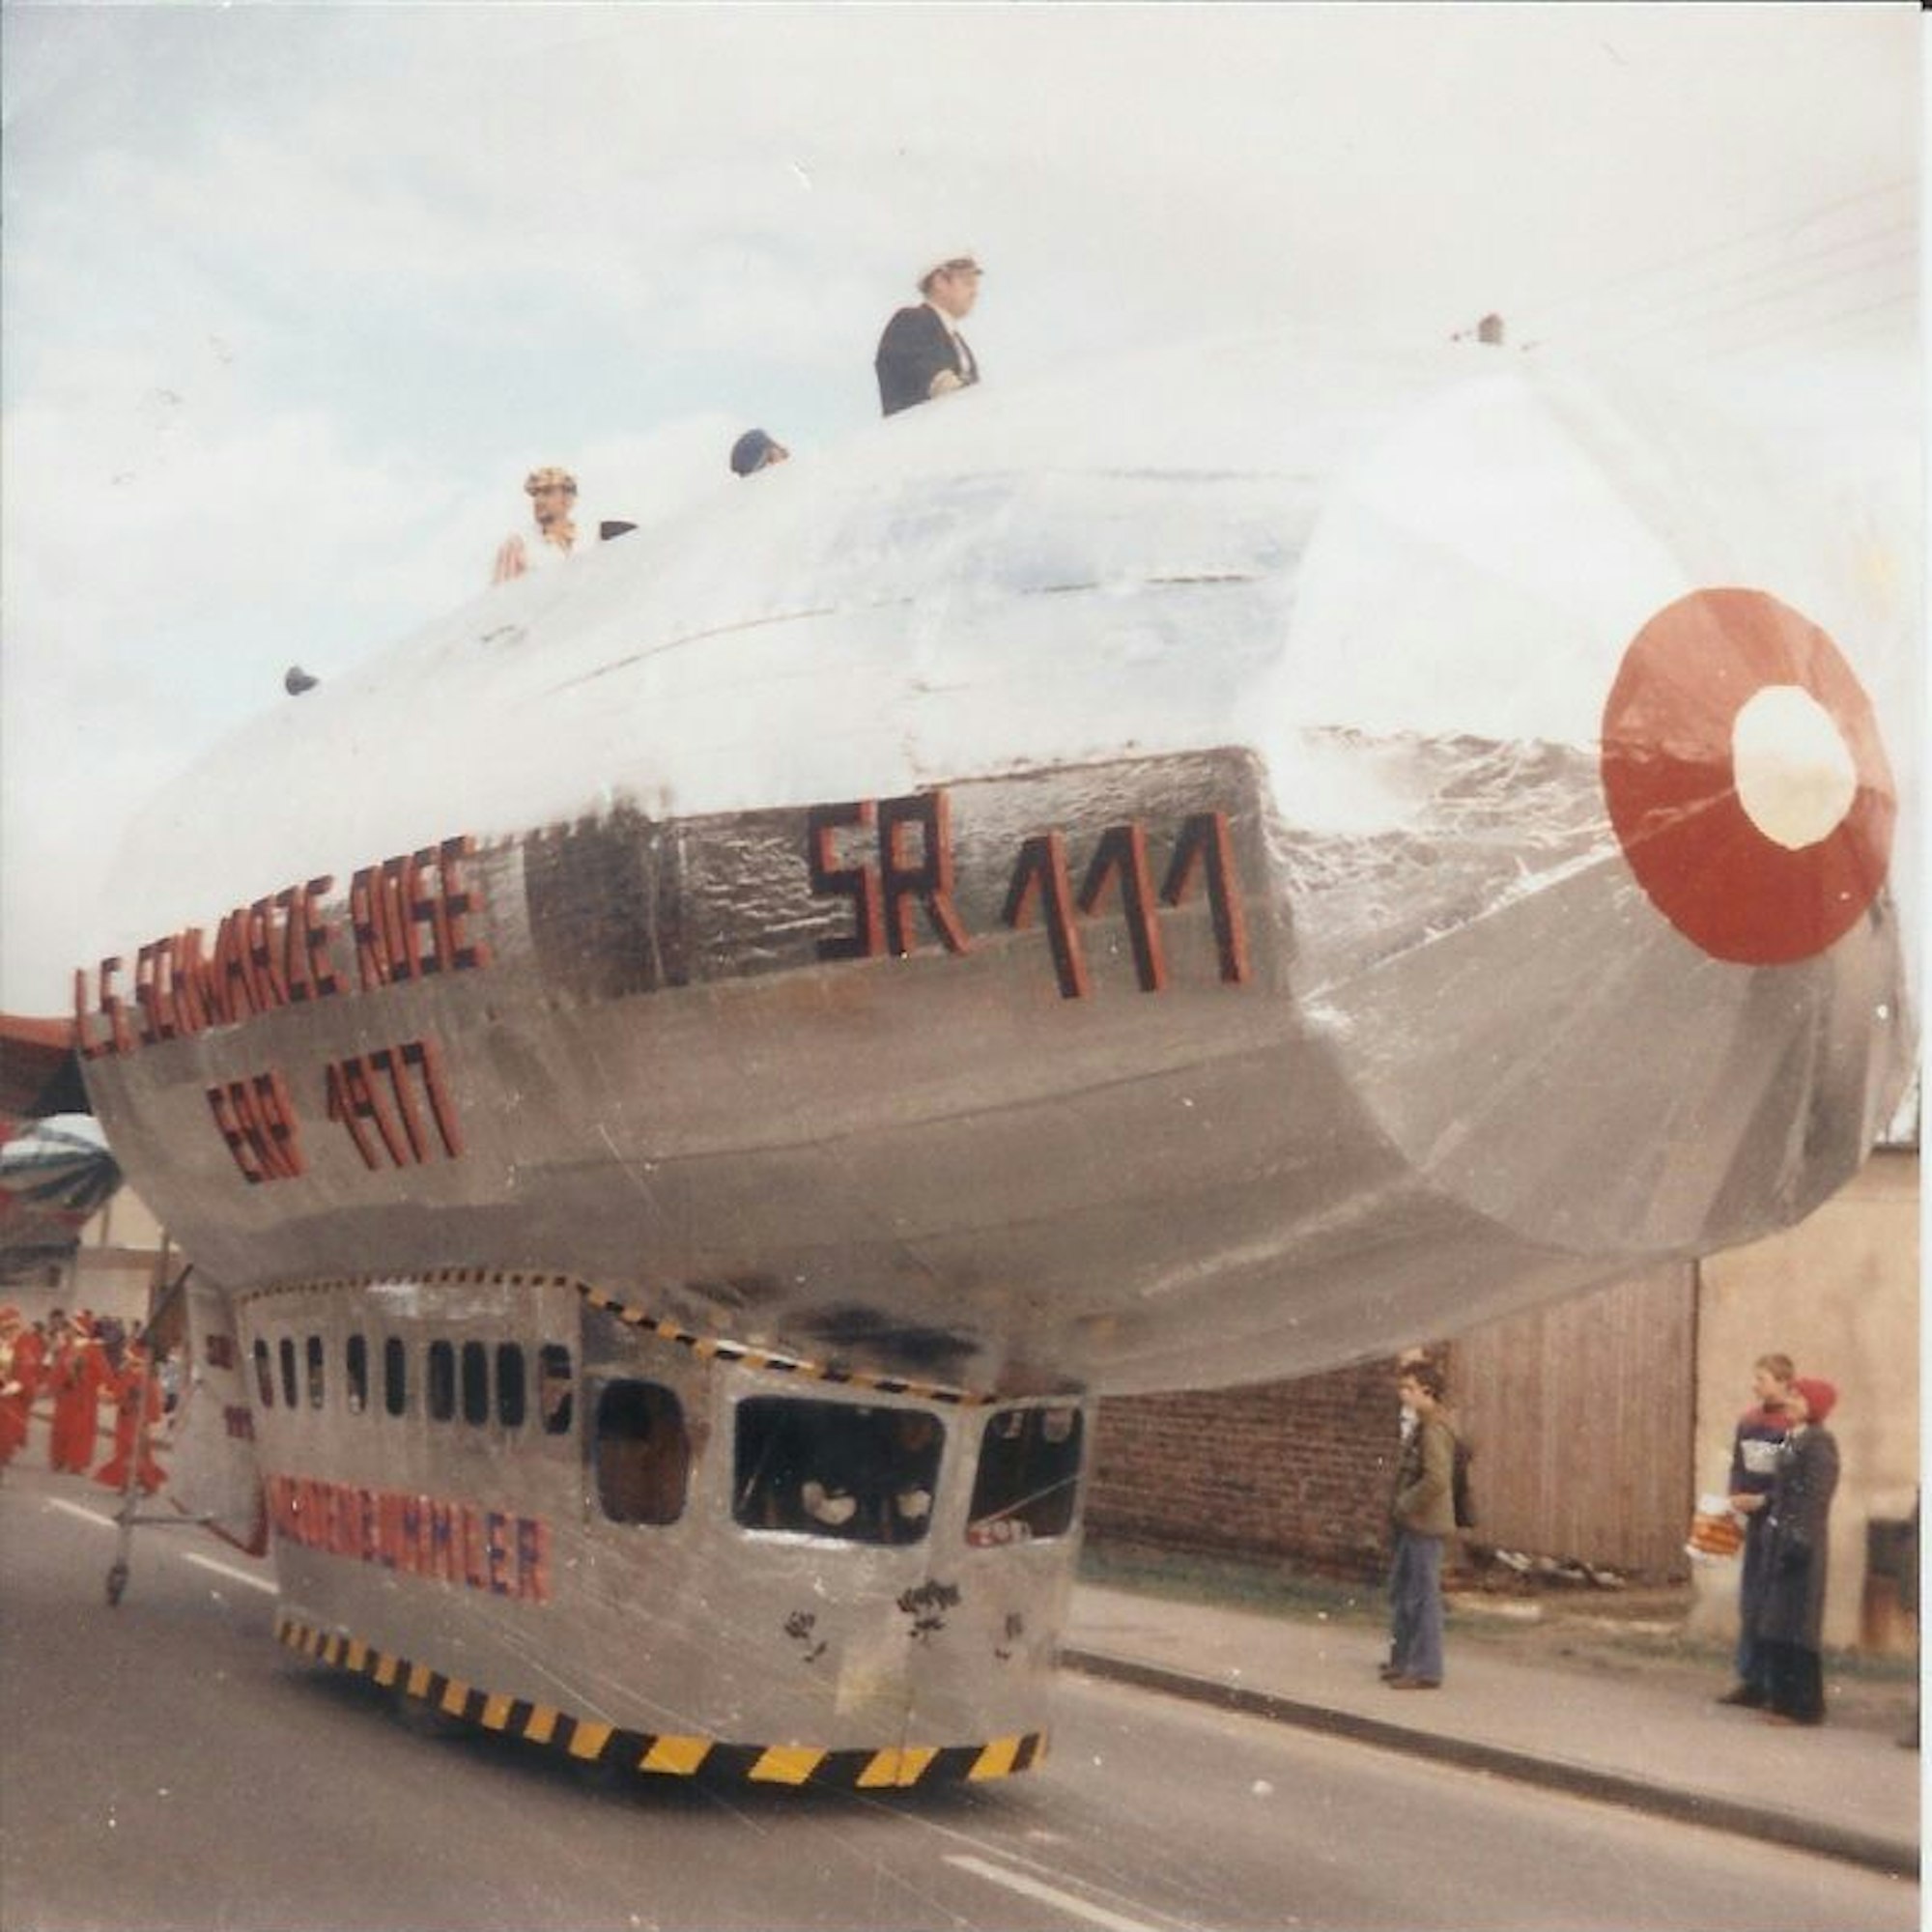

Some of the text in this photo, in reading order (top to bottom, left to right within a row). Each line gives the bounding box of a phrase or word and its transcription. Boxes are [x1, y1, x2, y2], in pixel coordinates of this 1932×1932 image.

[352, 836, 488, 992] ROSE
[809, 788, 1251, 1000] SR 111
[327, 1039, 463, 1170] 1977
